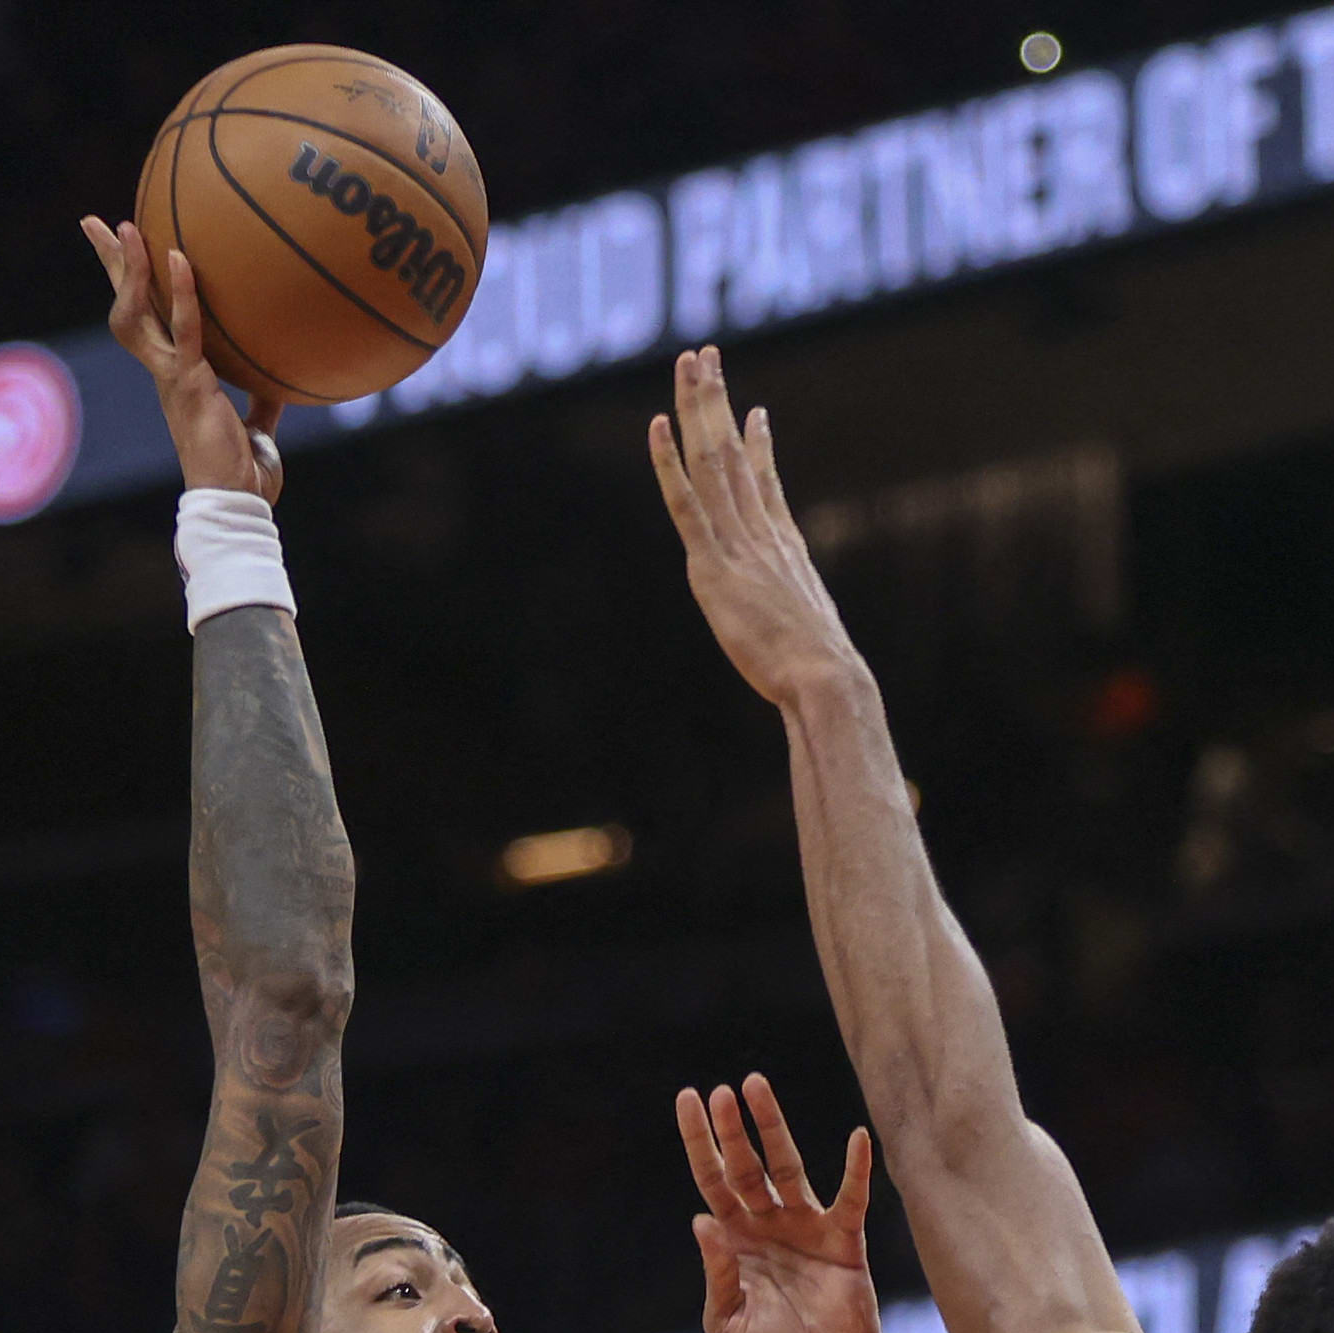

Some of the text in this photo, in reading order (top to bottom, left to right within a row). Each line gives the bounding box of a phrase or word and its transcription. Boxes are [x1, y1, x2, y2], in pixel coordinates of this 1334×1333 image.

[289, 140, 465, 325] Wilson
[670, 69, 1129, 342] PARTNER
[1133, 28, 1281, 222] OF
